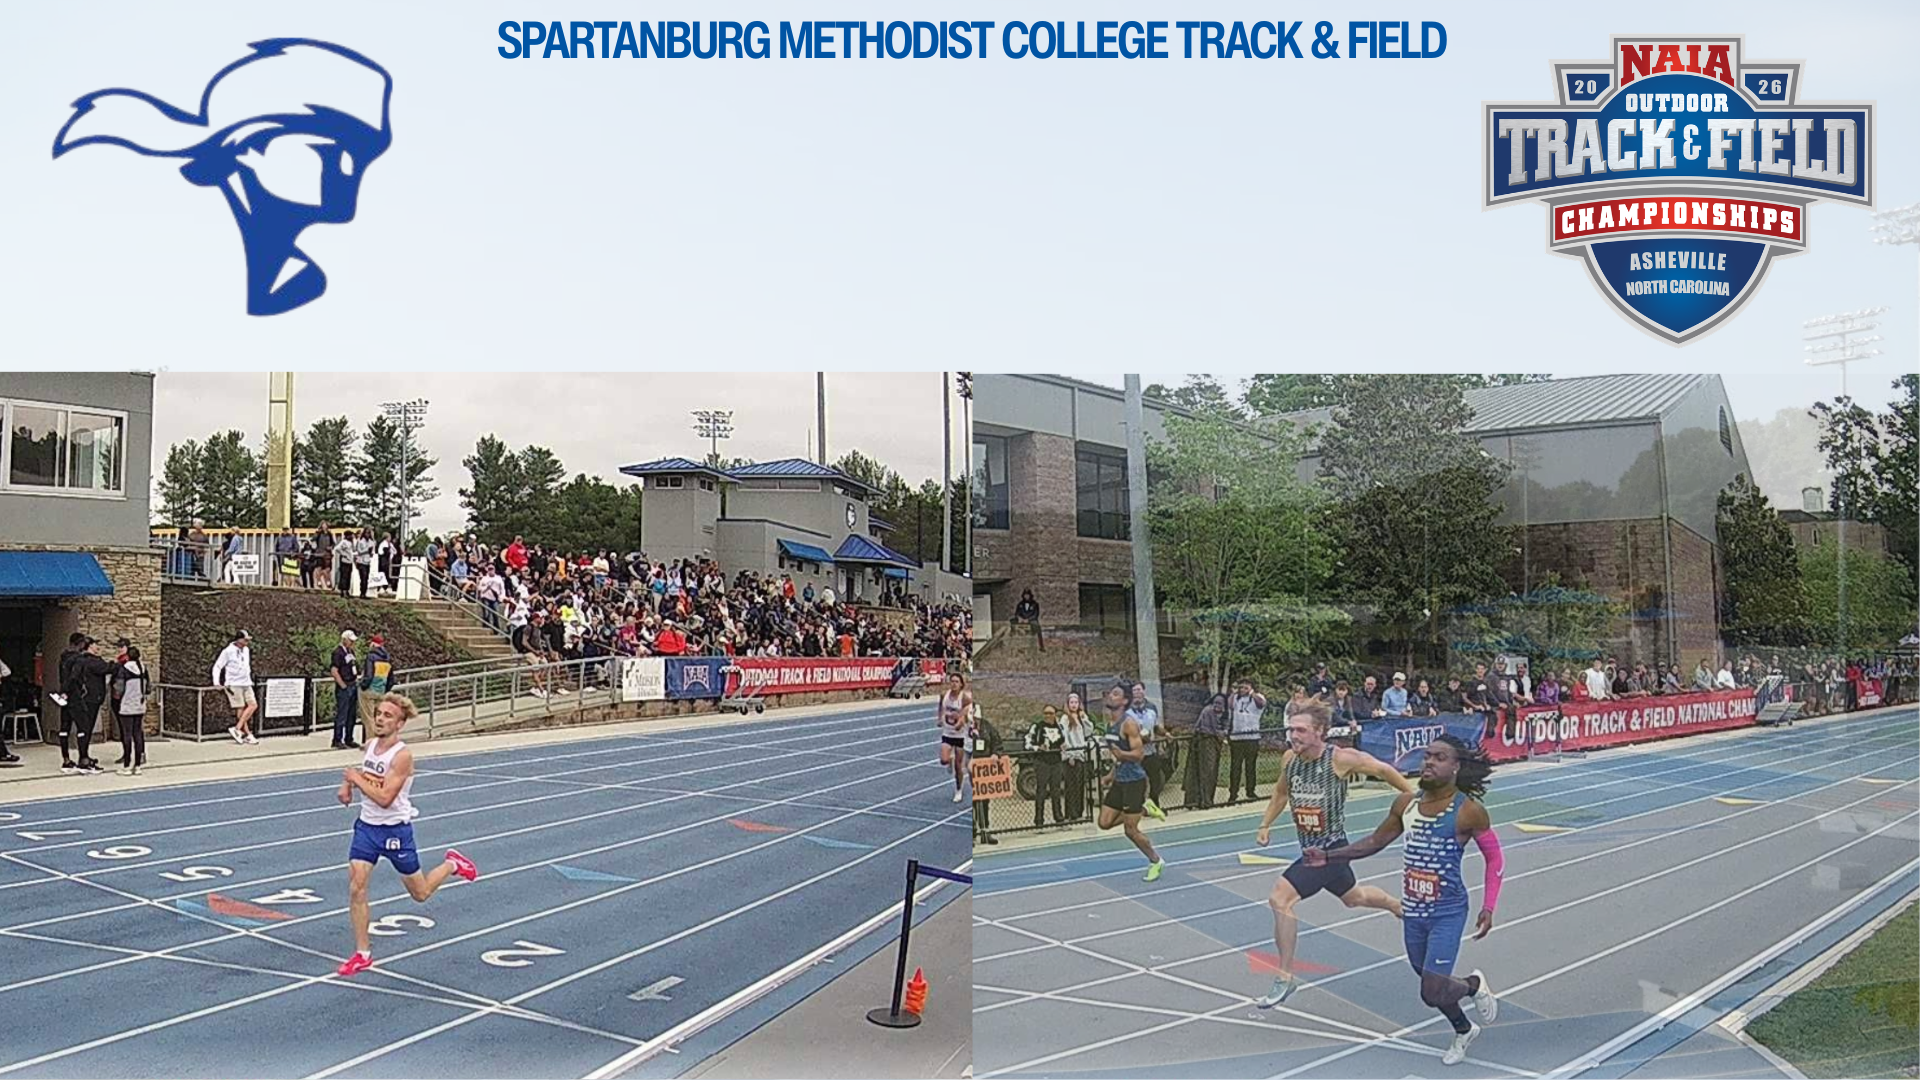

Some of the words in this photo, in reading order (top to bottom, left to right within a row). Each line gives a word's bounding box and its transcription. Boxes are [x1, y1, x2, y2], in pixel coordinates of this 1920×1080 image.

[1583, 710, 1628, 737] TRACK
[1629, 708, 1642, 732] &
[1643, 706, 1676, 729] FIELD
[1678, 700, 1727, 725] NATIONAL
[250, 888, 324, 905] 4
[1408, 877, 1434, 896] 1189
[368, 914, 436, 937] 3
[480, 940, 567, 968] 2
